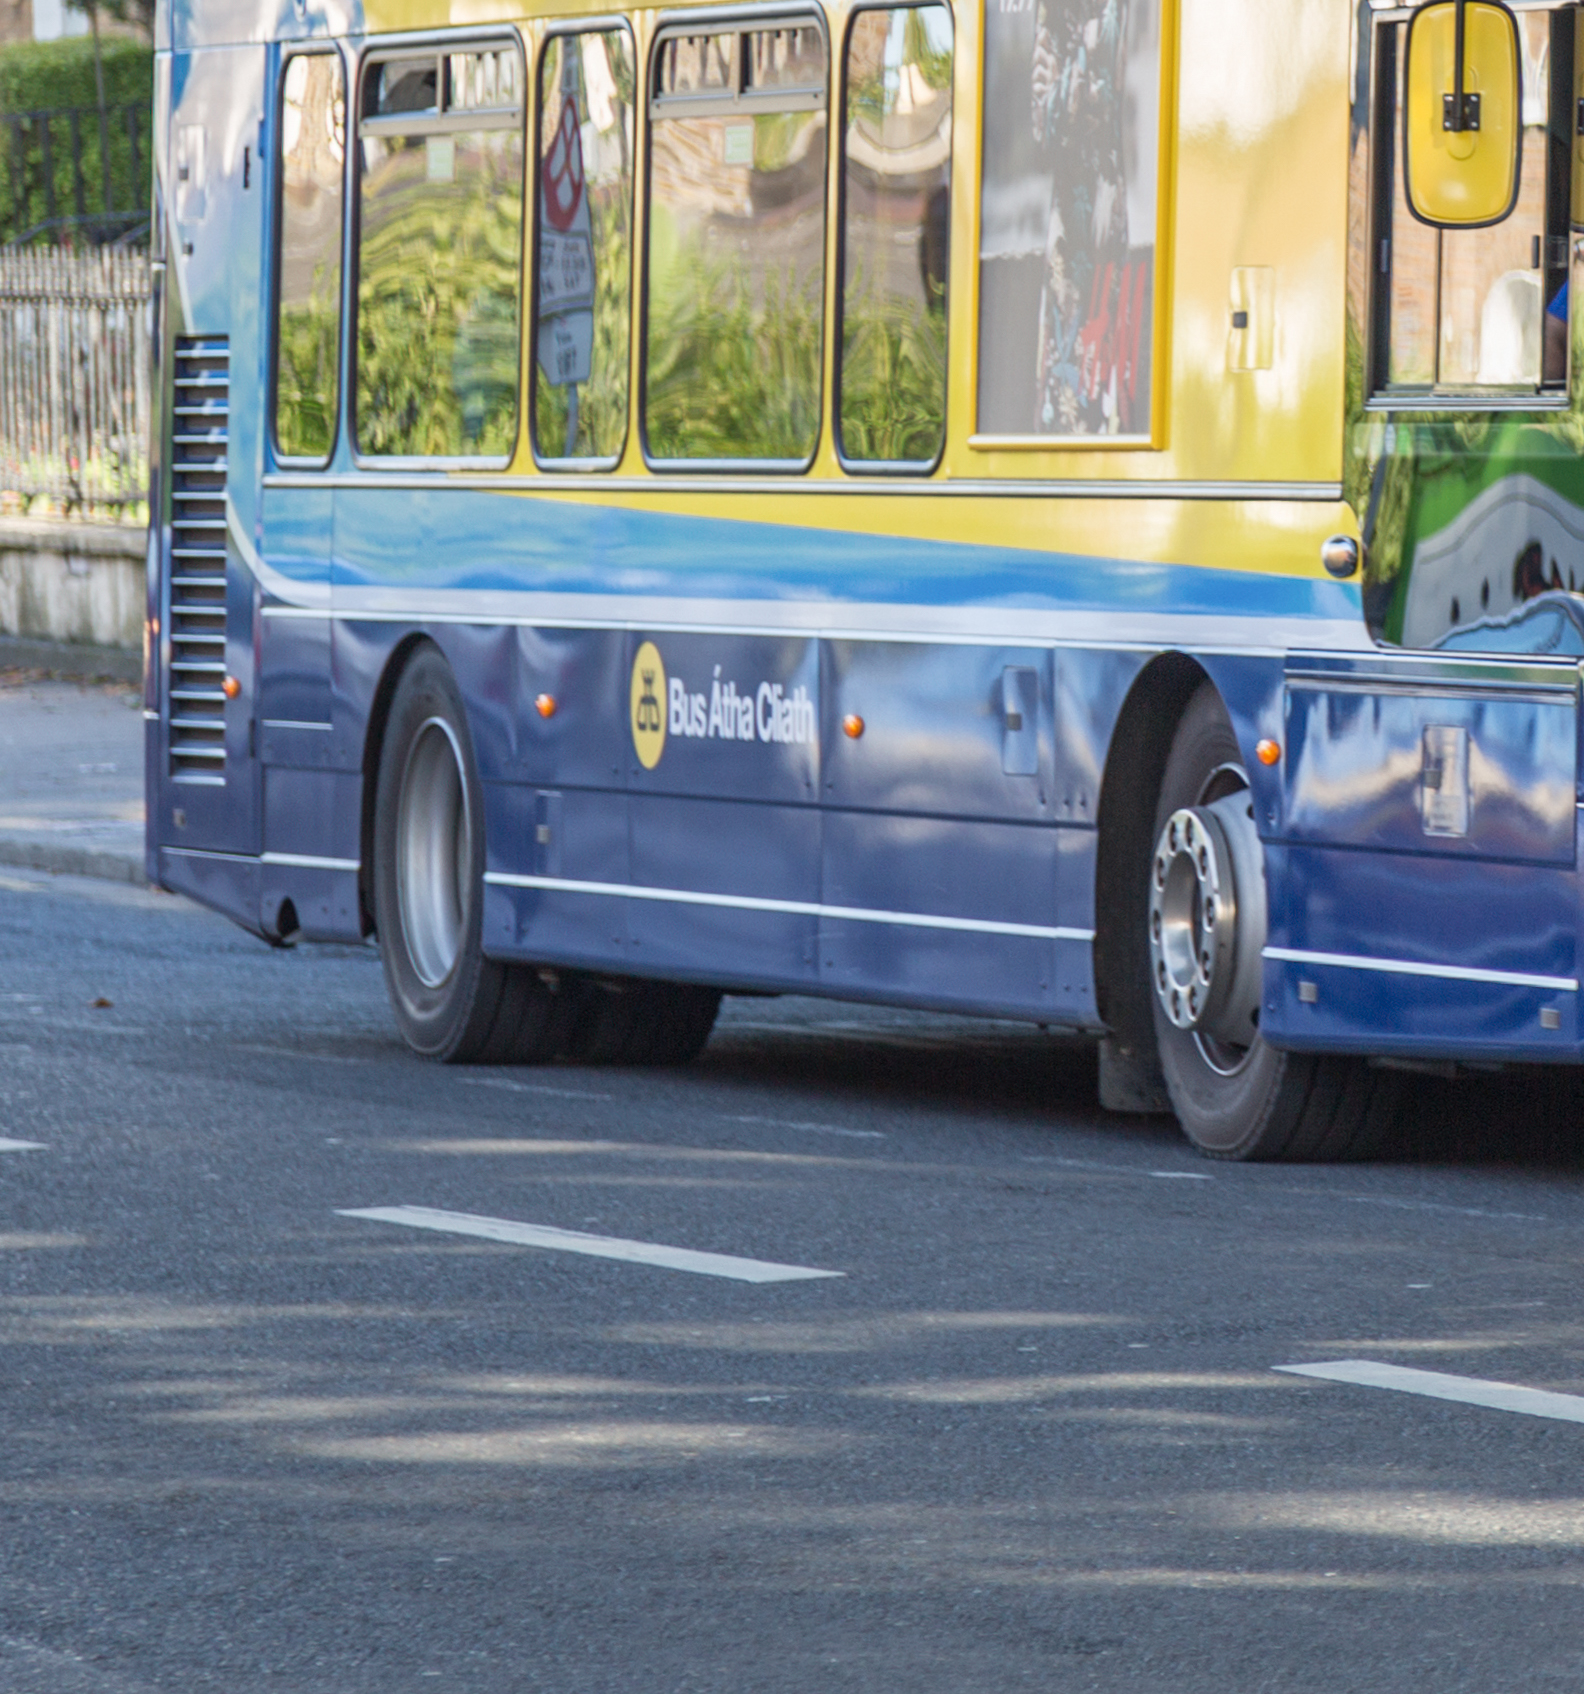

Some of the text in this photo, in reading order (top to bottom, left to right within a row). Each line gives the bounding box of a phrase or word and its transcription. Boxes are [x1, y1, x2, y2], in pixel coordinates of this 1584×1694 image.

[669, 664, 815, 743] Bus Átha Cliath
